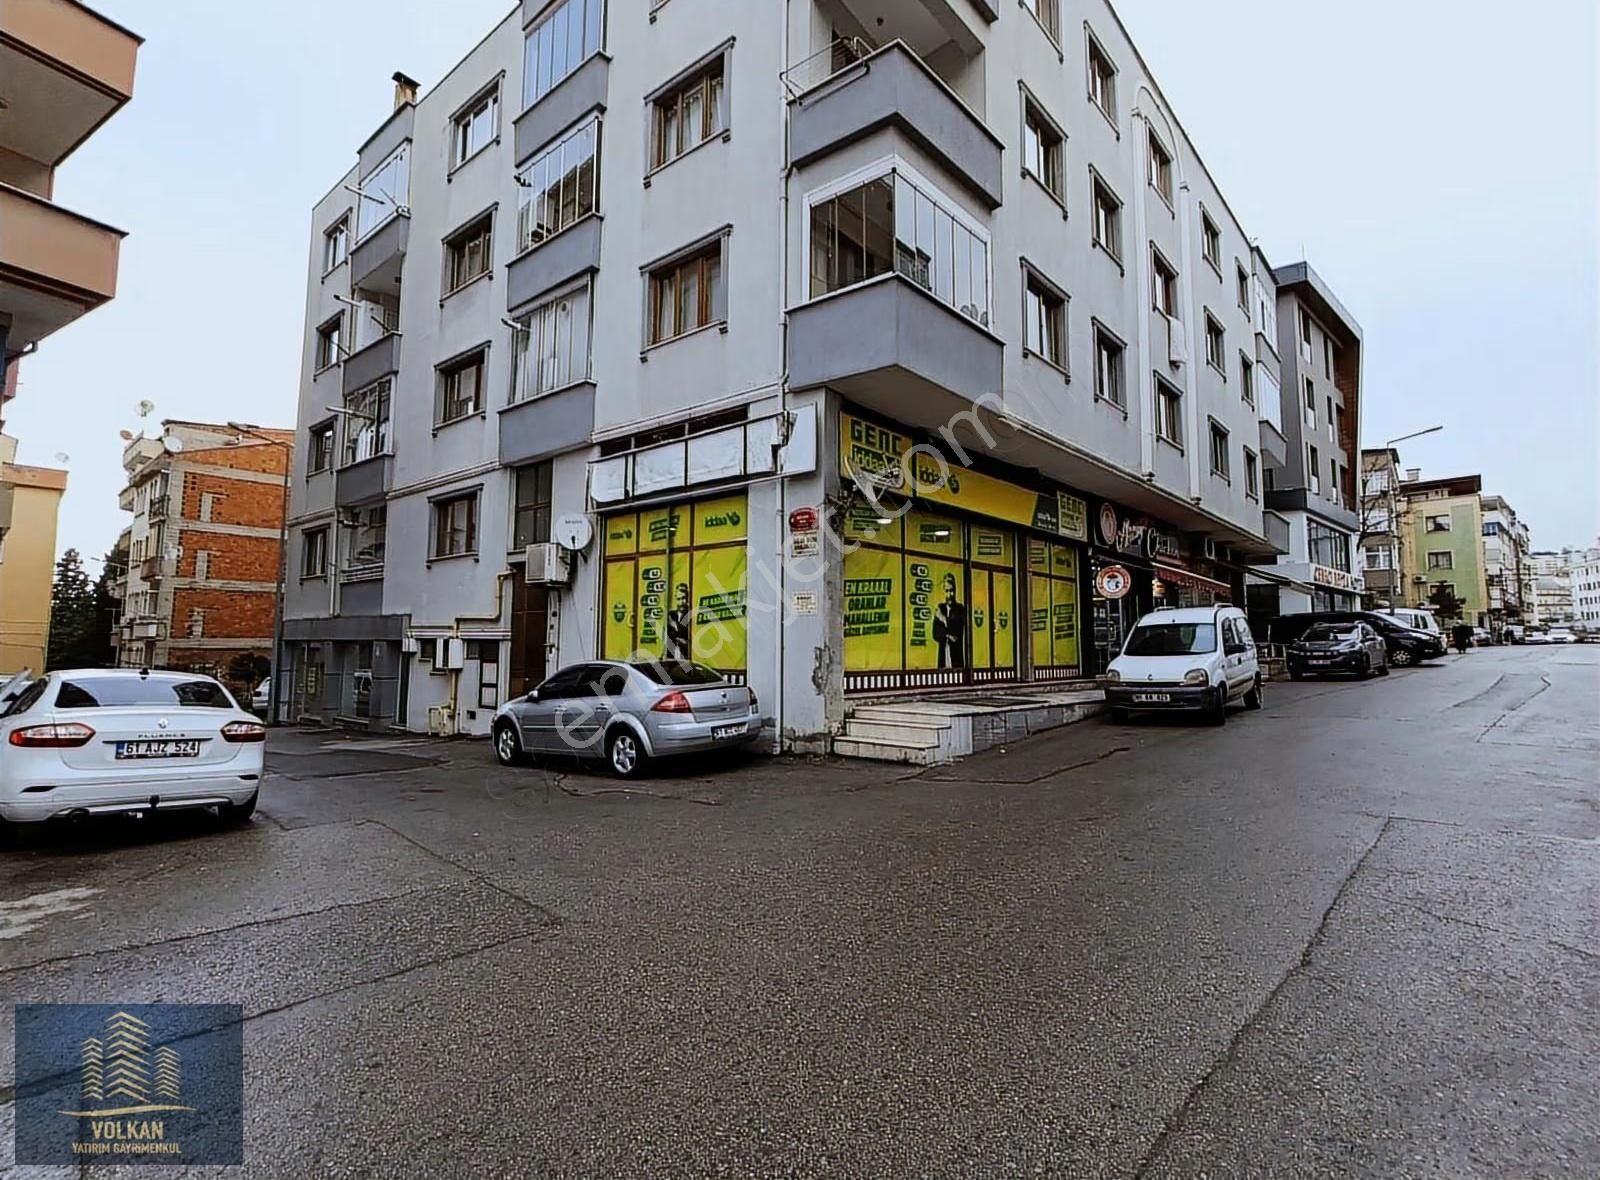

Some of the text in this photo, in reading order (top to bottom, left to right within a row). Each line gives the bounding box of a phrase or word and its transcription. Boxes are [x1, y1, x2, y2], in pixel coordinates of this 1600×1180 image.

[126, 740, 197, 754] 61 AJZ 524
